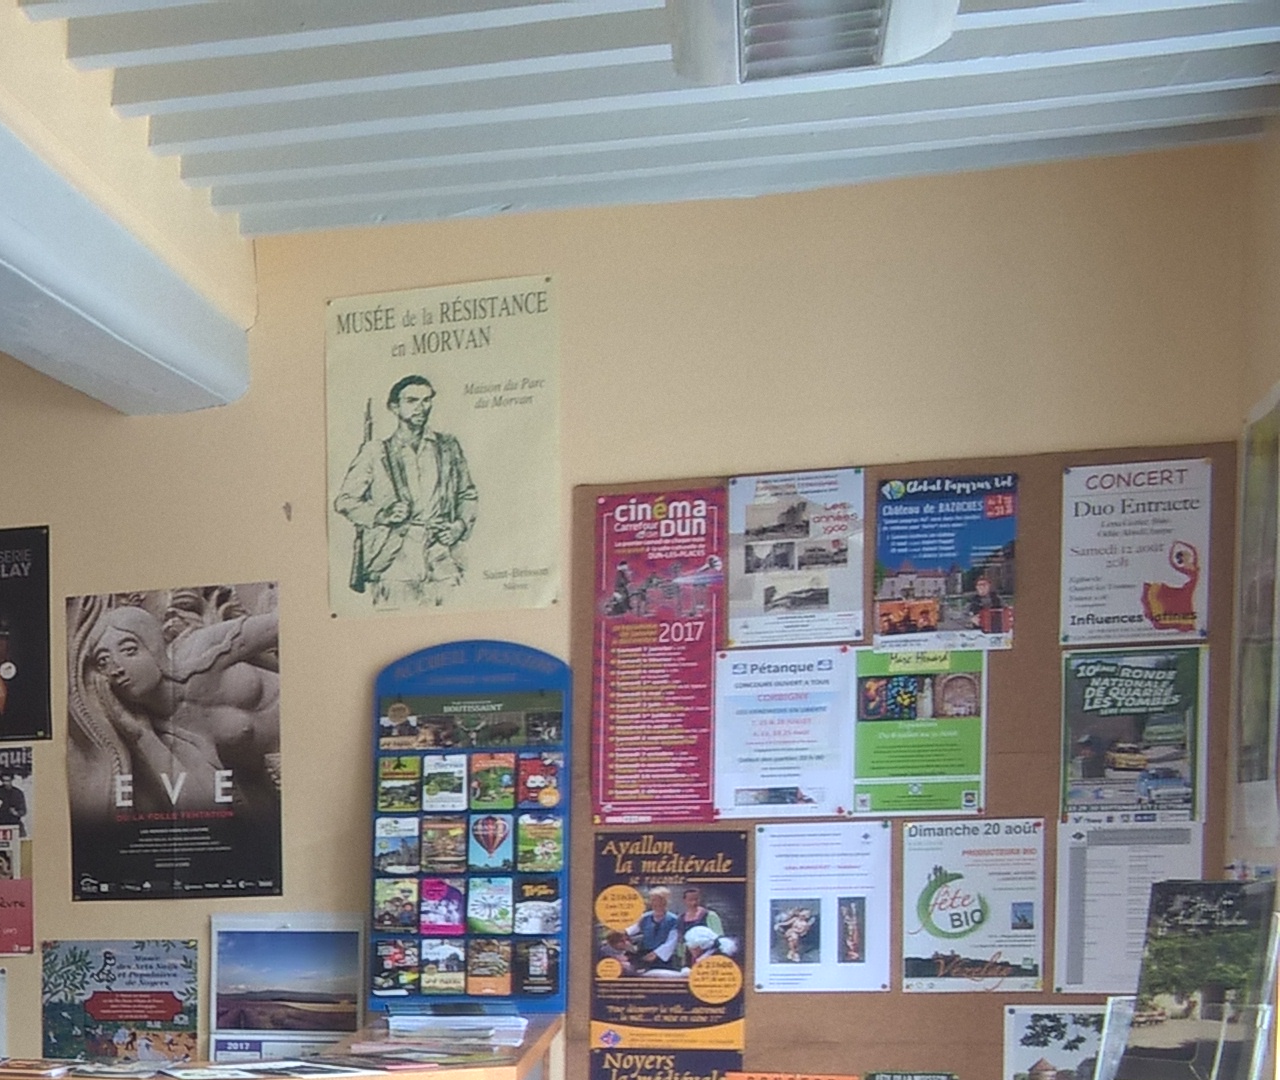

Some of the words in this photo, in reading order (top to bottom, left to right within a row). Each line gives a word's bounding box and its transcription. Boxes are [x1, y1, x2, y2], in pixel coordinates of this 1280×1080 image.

[336, 305, 395, 335] MUSÉE
[402, 310, 418, 327] de
[423, 308, 433, 325] la
[440, 291, 548, 322] RÉSISTANCE
[391, 344, 406, 357] en
[412, 326, 491, 355] MORVAN
[1086, 468, 1188, 490] CONCERT
[614, 496, 706, 522] cinéma
[1073, 501, 1115, 518] Duo
[1121, 497, 1200, 515] Entracte
[1070, 613, 1143, 625] Influences
[659, 621, 705, 643] 2017
[750, 661, 814, 675] Pétanque
[1120, 667, 1177, 679] RONDE
[1084, 697, 1112, 710] LES
[1085, 688, 1105, 698] DE
[908, 823, 980, 838] Dimanche
[984, 823, 1000, 835] 20
[1005, 821, 1038, 835] août
[602, 834, 674, 855] Avallon
[615, 854, 633, 873] la
[641, 852, 732, 873] médiévale
[929, 885, 975, 917] fête
[949, 908, 985, 929] BIO
[227, 1041, 251, 1050] 2017
[603, 1053, 675, 1078] Noyers
